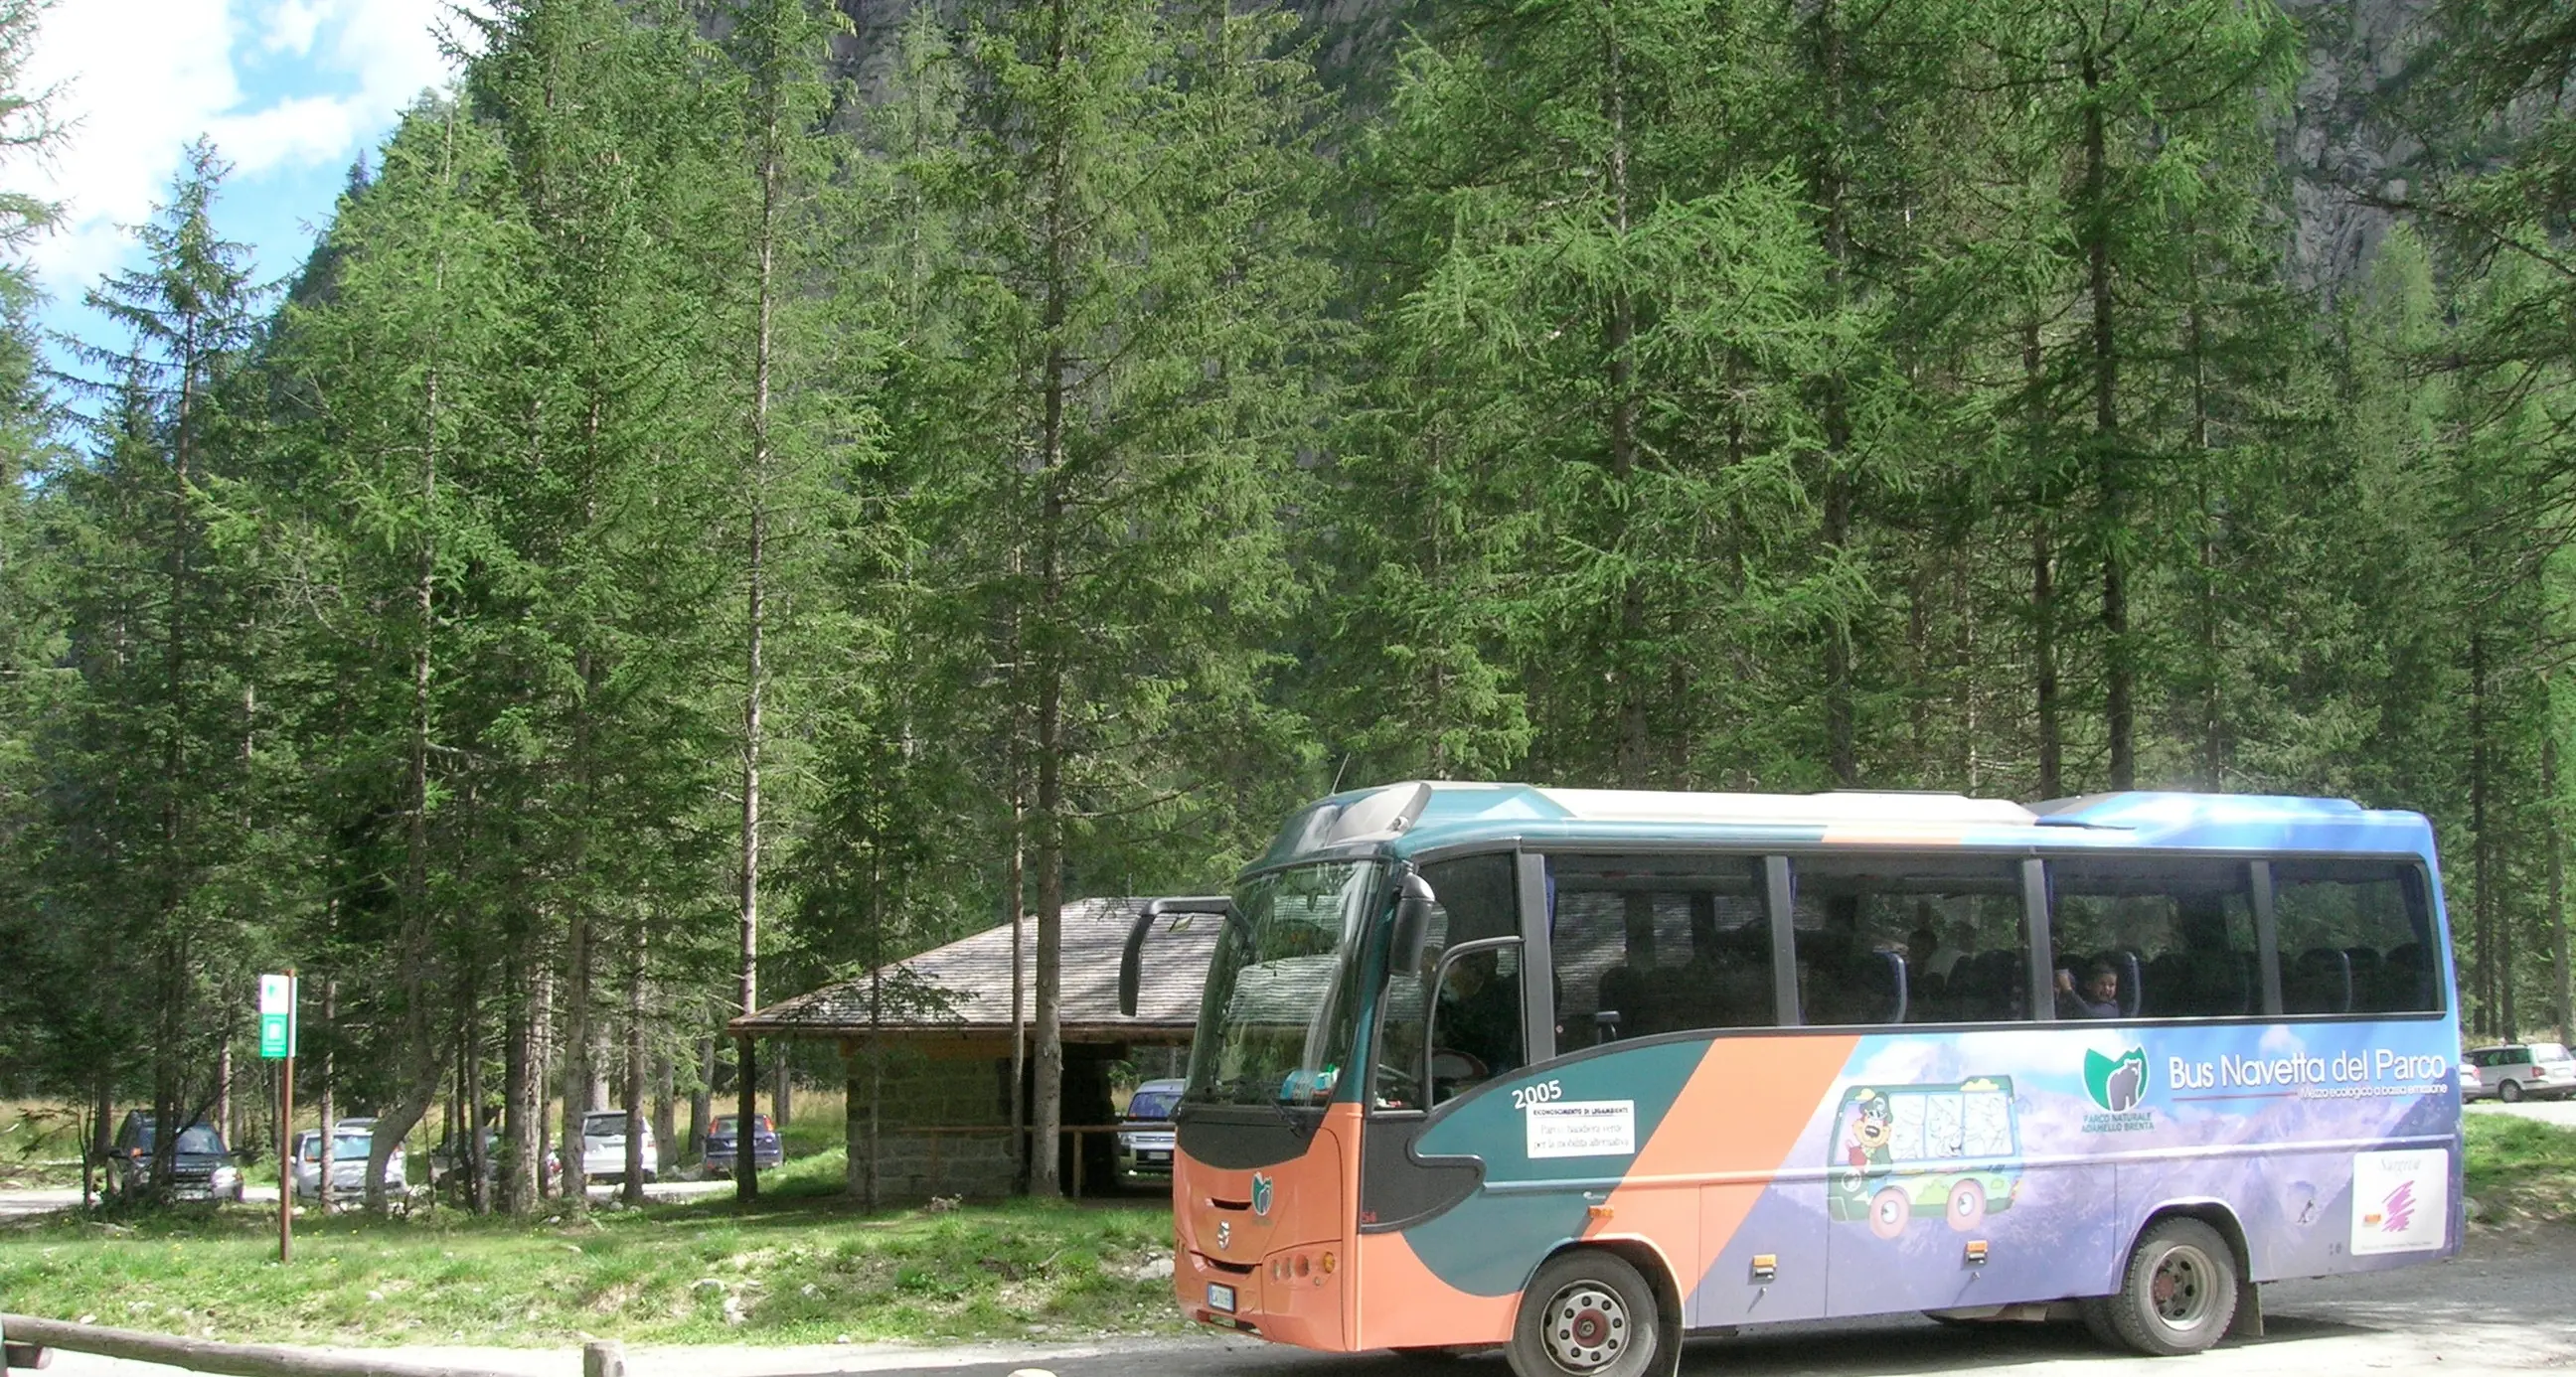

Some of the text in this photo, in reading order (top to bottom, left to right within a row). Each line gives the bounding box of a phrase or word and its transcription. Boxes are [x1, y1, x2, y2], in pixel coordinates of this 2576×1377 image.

[2169, 1048, 2446, 1090] Bus Navetta del Parco
[1512, 1079, 1562, 1110] 2005
[2302, 1087, 2329, 1099] Mezzo
[2330, 1086, 2372, 1099] ecologico
[2083, 1112, 2152, 1123] PARCO NATURALE
